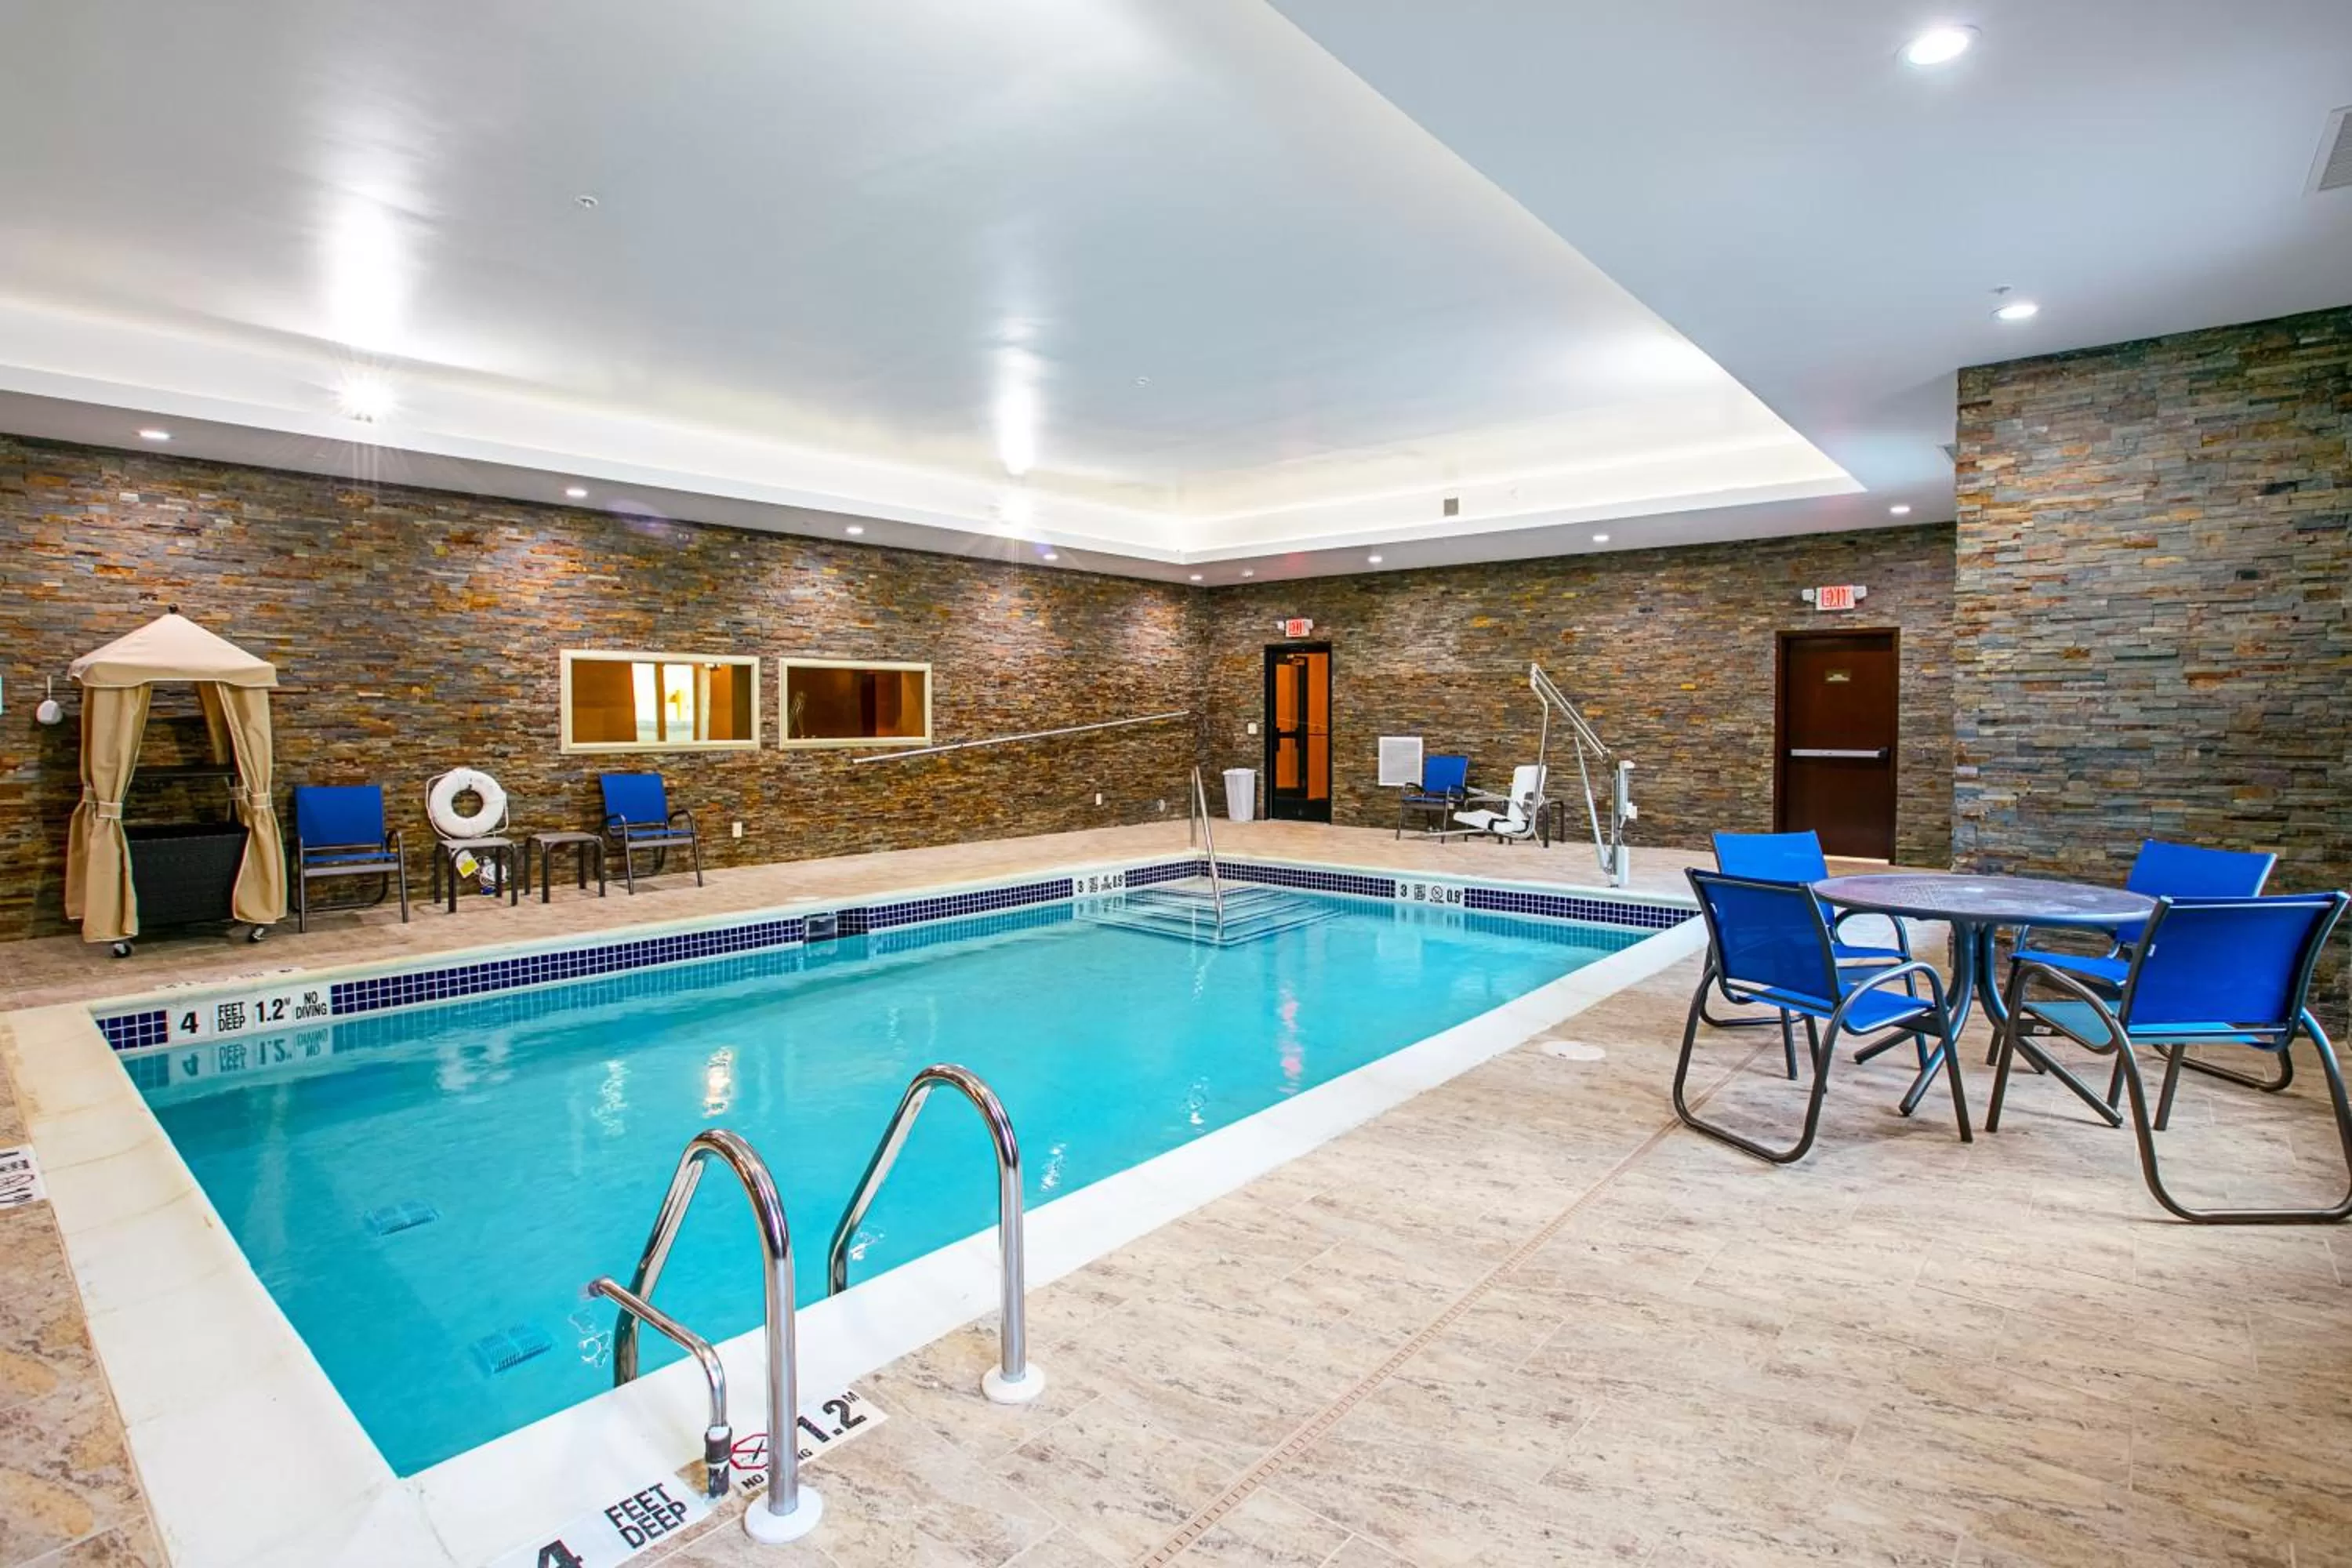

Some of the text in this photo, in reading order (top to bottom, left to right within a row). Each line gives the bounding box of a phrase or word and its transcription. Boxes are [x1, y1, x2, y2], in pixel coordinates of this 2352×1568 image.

[1822, 587, 1849, 607] EXIT
[1400, 884, 1407, 898] 3
[303, 990, 318, 1004] NO
[218, 1001, 245, 1018] FEET
[296, 1003, 327, 1020] DIVING
[180, 1011, 199, 1033] 4
[218, 1015, 245, 1032] DEEP
[741, 1474, 764, 1490] NO
[604, 1482, 673, 1529] FEET
[619, 1501, 688, 1550] DEEP
